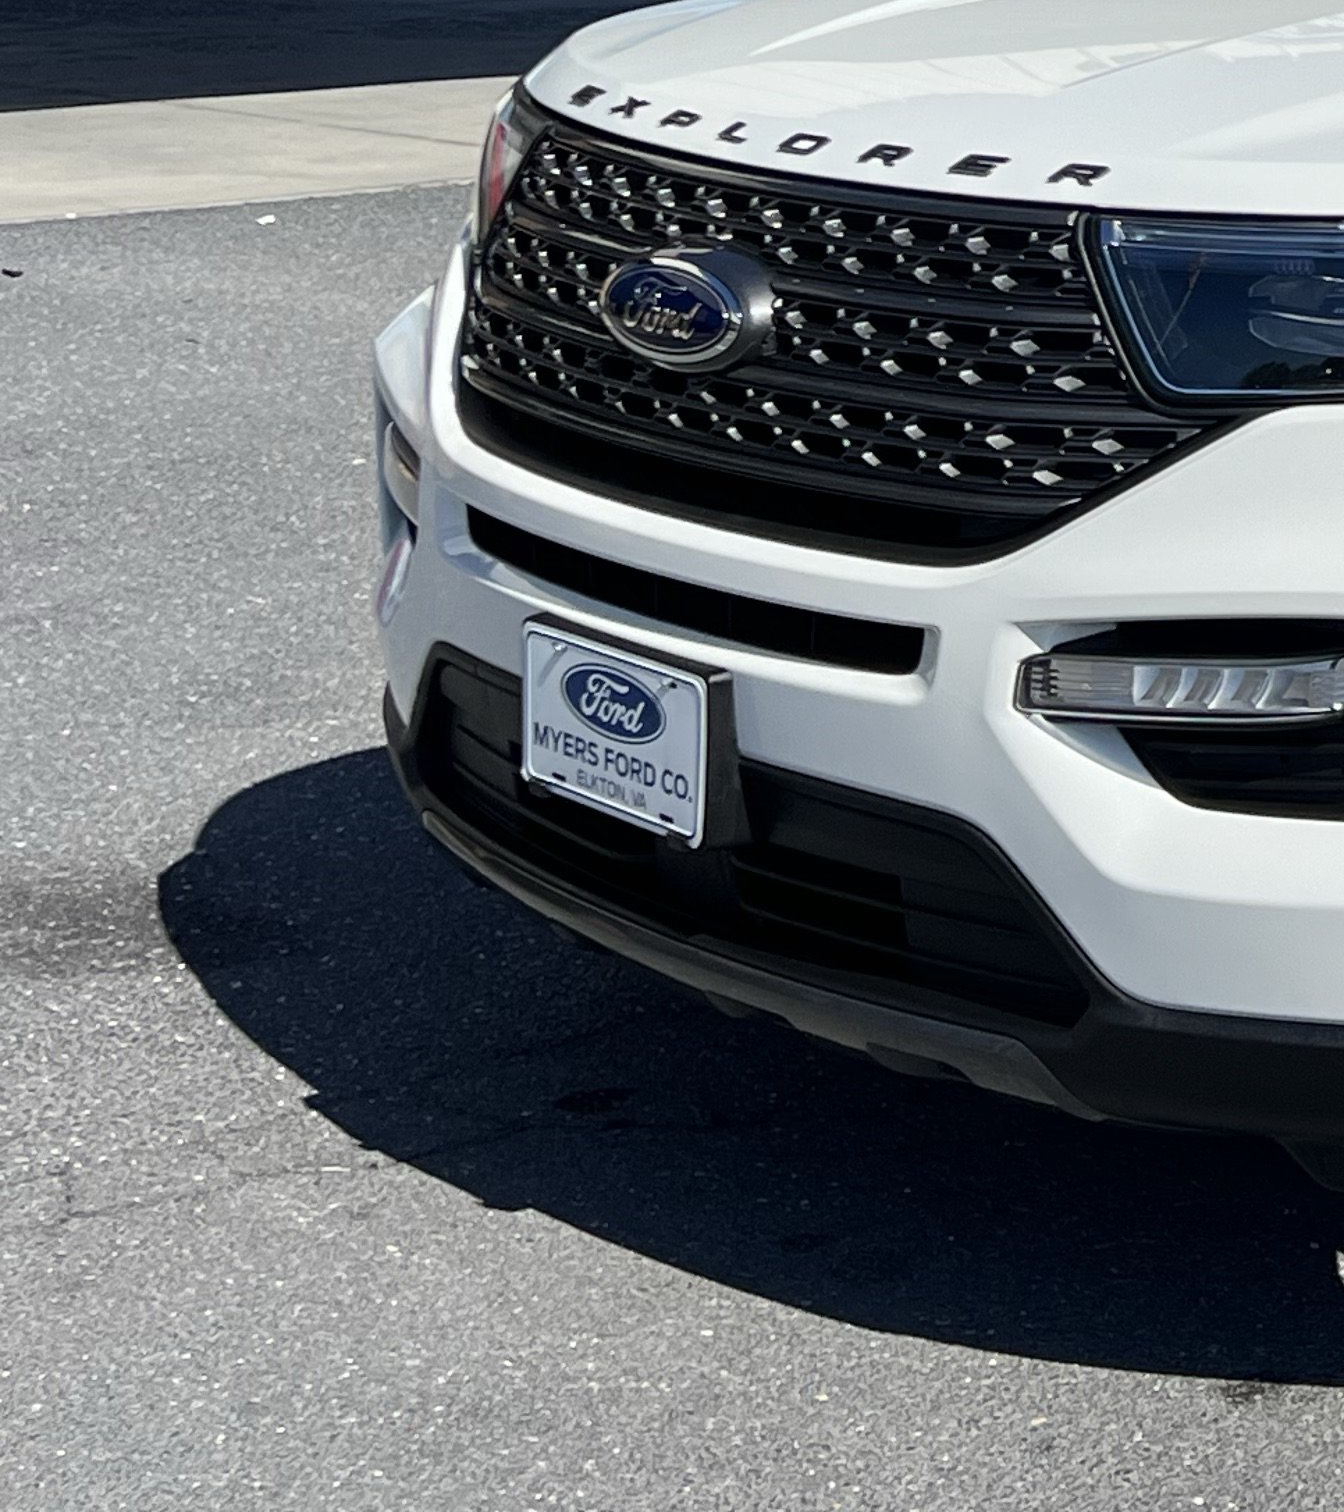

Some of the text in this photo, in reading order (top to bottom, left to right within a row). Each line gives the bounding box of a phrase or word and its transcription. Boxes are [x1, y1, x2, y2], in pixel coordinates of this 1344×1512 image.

[568, 85, 1111, 186] EXPLORER
[623, 276, 702, 340] Ford
[580, 673, 646, 733] Ford
[533, 722, 693, 803] MYERS FORD CO.
[632, 792, 647, 811] VA
